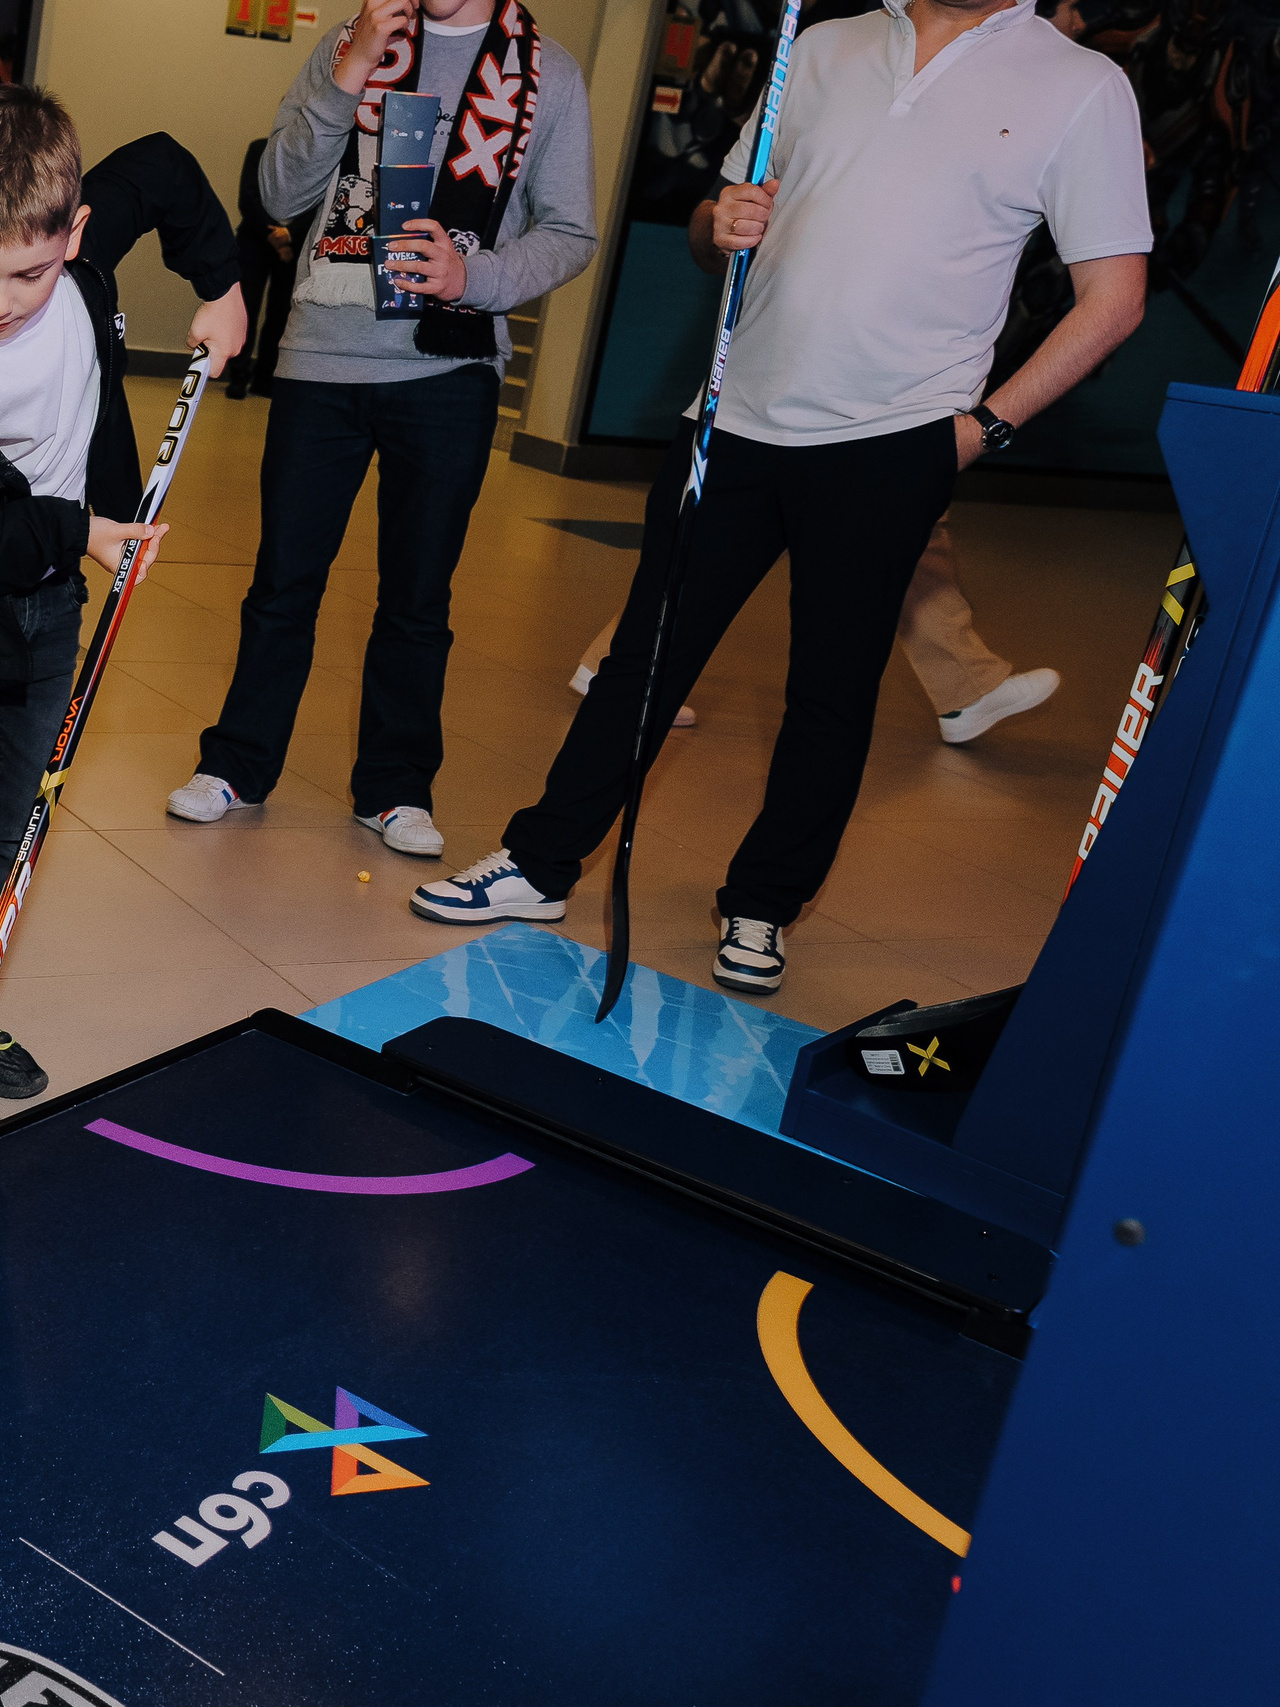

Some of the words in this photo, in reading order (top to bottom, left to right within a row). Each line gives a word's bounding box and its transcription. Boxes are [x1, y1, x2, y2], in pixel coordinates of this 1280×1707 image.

[761, 12, 797, 134] BAUER
[710, 328, 731, 392] BAUER
[112, 570, 127, 593] FLEX
[120, 557, 131, 570] 30
[49, 695, 84, 764] VAPOR
[17, 805, 41, 862] JUNIOR
